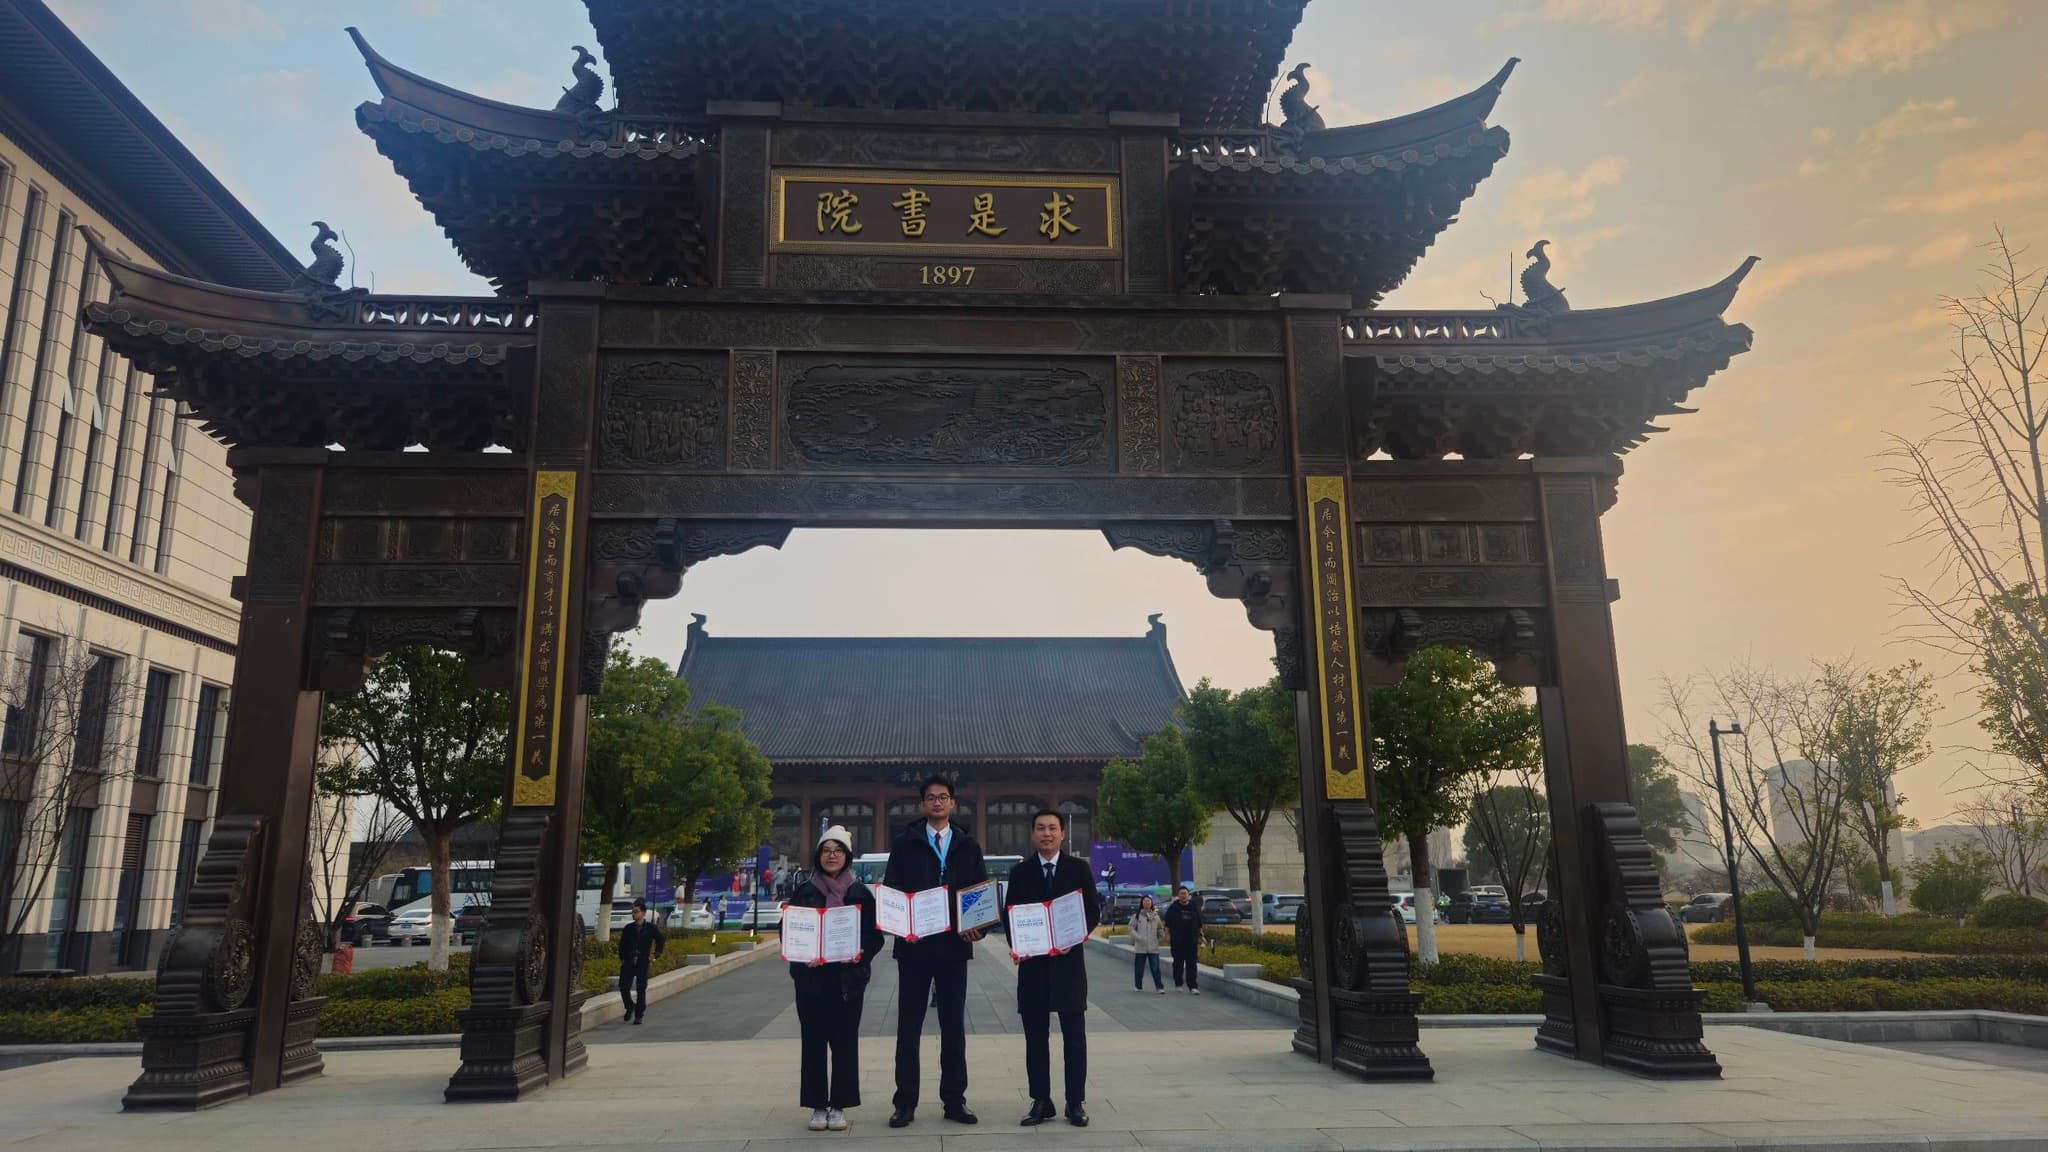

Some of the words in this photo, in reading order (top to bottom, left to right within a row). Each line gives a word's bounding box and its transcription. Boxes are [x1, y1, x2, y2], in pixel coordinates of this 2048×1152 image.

[816, 188, 1081, 240] 求是書院
[919, 265, 977, 286] 1897
